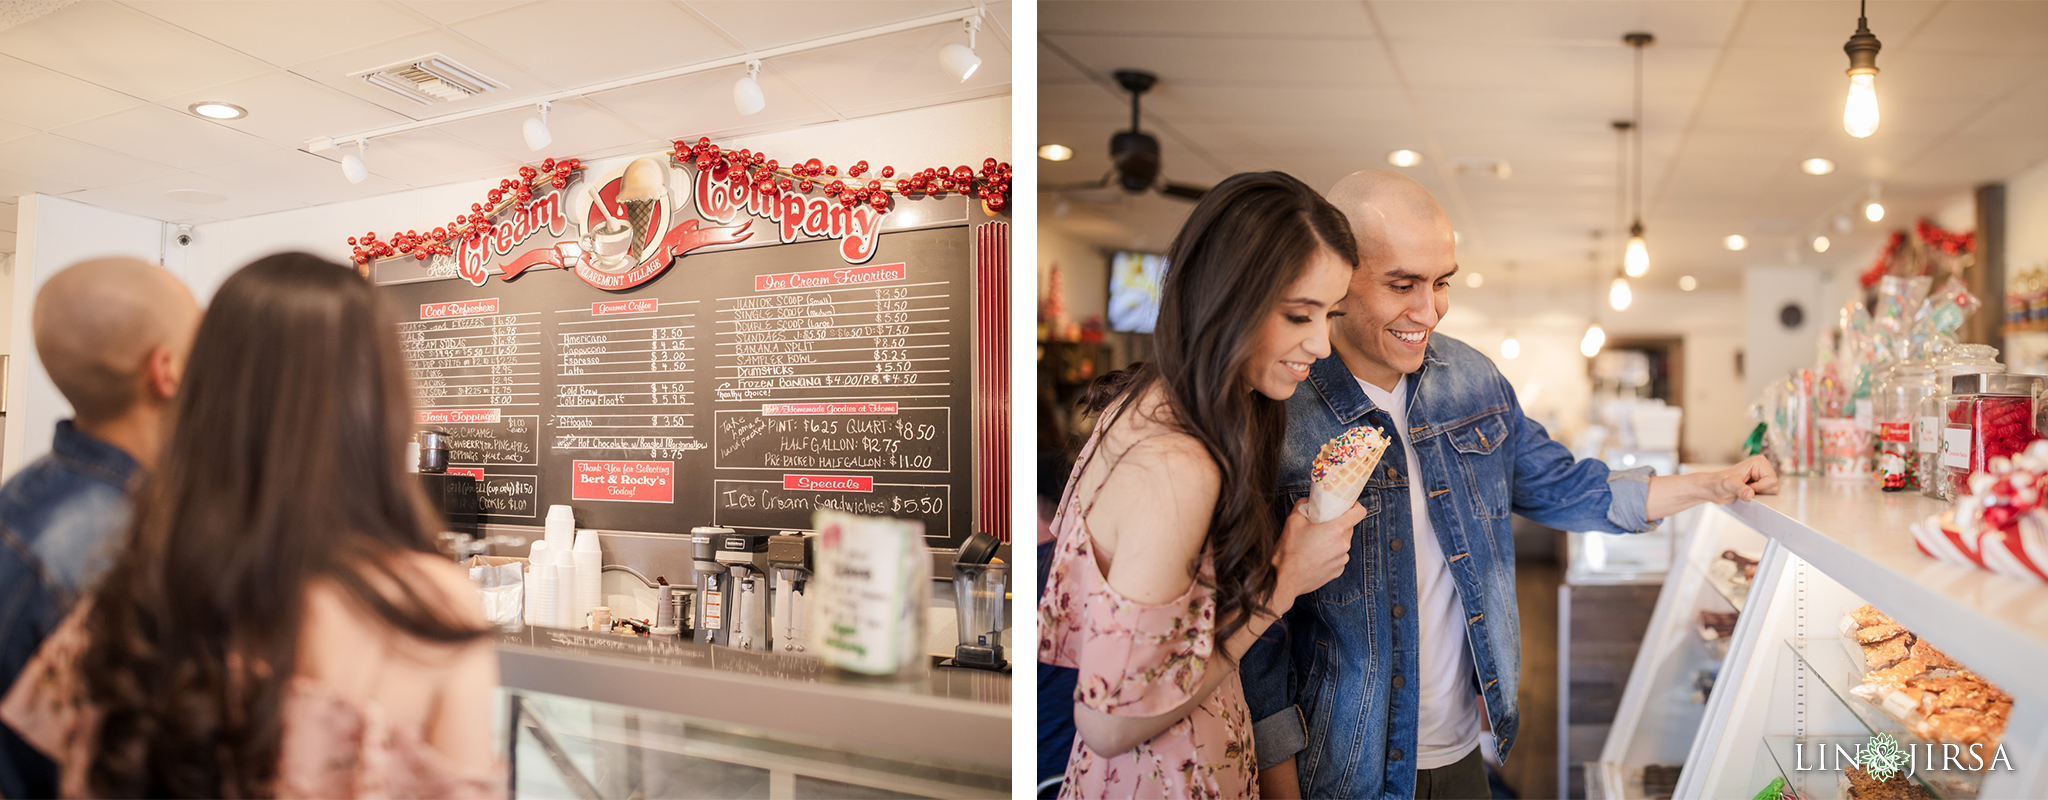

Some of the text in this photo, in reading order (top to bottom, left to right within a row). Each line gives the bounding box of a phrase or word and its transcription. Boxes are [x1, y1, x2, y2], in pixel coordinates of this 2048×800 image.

[695, 159, 888, 263] Company
[456, 190, 567, 287] Cream
[580, 258, 662, 287] CLAREMONT VILLAGE
[763, 269, 898, 289] Ice Cream Favorites
[733, 298, 773, 309] JUNIOR
[776, 295, 804, 306] SCOOP
[875, 288, 908, 299] $3.50
[425, 302, 495, 317] Cool Refreshers
[599, 302, 652, 314] Gourmet Coffee
[734, 309, 773, 320] SINGLE
[777, 308, 804, 318] SCOOP
[874, 301, 908, 312] $4.50
[734, 320, 772, 332] DOUBLE
[777, 318, 804, 330] SCOOP
[874, 312, 908, 323] $5.50
[564, 334, 607, 343] Americano
[735, 331, 786, 343] SUNDAES
[563, 344, 606, 356] Cappuccino
[736, 343, 778, 354] BANANA
[784, 342, 814, 352] SPLIT
[564, 356, 600, 366] Espresso
[736, 355, 784, 366] SAMPLER
[788, 354, 816, 363] BOWL
[564, 365, 584, 375] Latte
[738, 362, 912, 377] Drumsticks $5.50
[560, 385, 578, 396] Cold
[580, 385, 598, 395] Brew
[720, 389, 771, 402] healthy choice!
[560, 396, 576, 406] Cold
[578, 396, 596, 405] Brew
[781, 405, 824, 413] Homemade
[826, 404, 856, 414] Goodies
[860, 404, 866, 412] at
[868, 404, 896, 412] Home
[420, 411, 496, 422] Tasty Toppings
[560, 416, 592, 430] Affogato
[720, 416, 746, 434] Take
[768, 419, 798, 434] PINT:
[846, 418, 892, 434] QUART:
[578, 437, 590, 448] Hot
[593, 437, 628, 448] Chocolate
[890, 454, 932, 468] $11.00
[578, 463, 670, 475] Thank You for Selecting
[580, 474, 666, 486] Bert & Rocky's
[798, 477, 859, 490] Specials
[608, 486, 636, 498] Today!
[723, 490, 943, 514] Ice Cream Sandwiches $5.50
